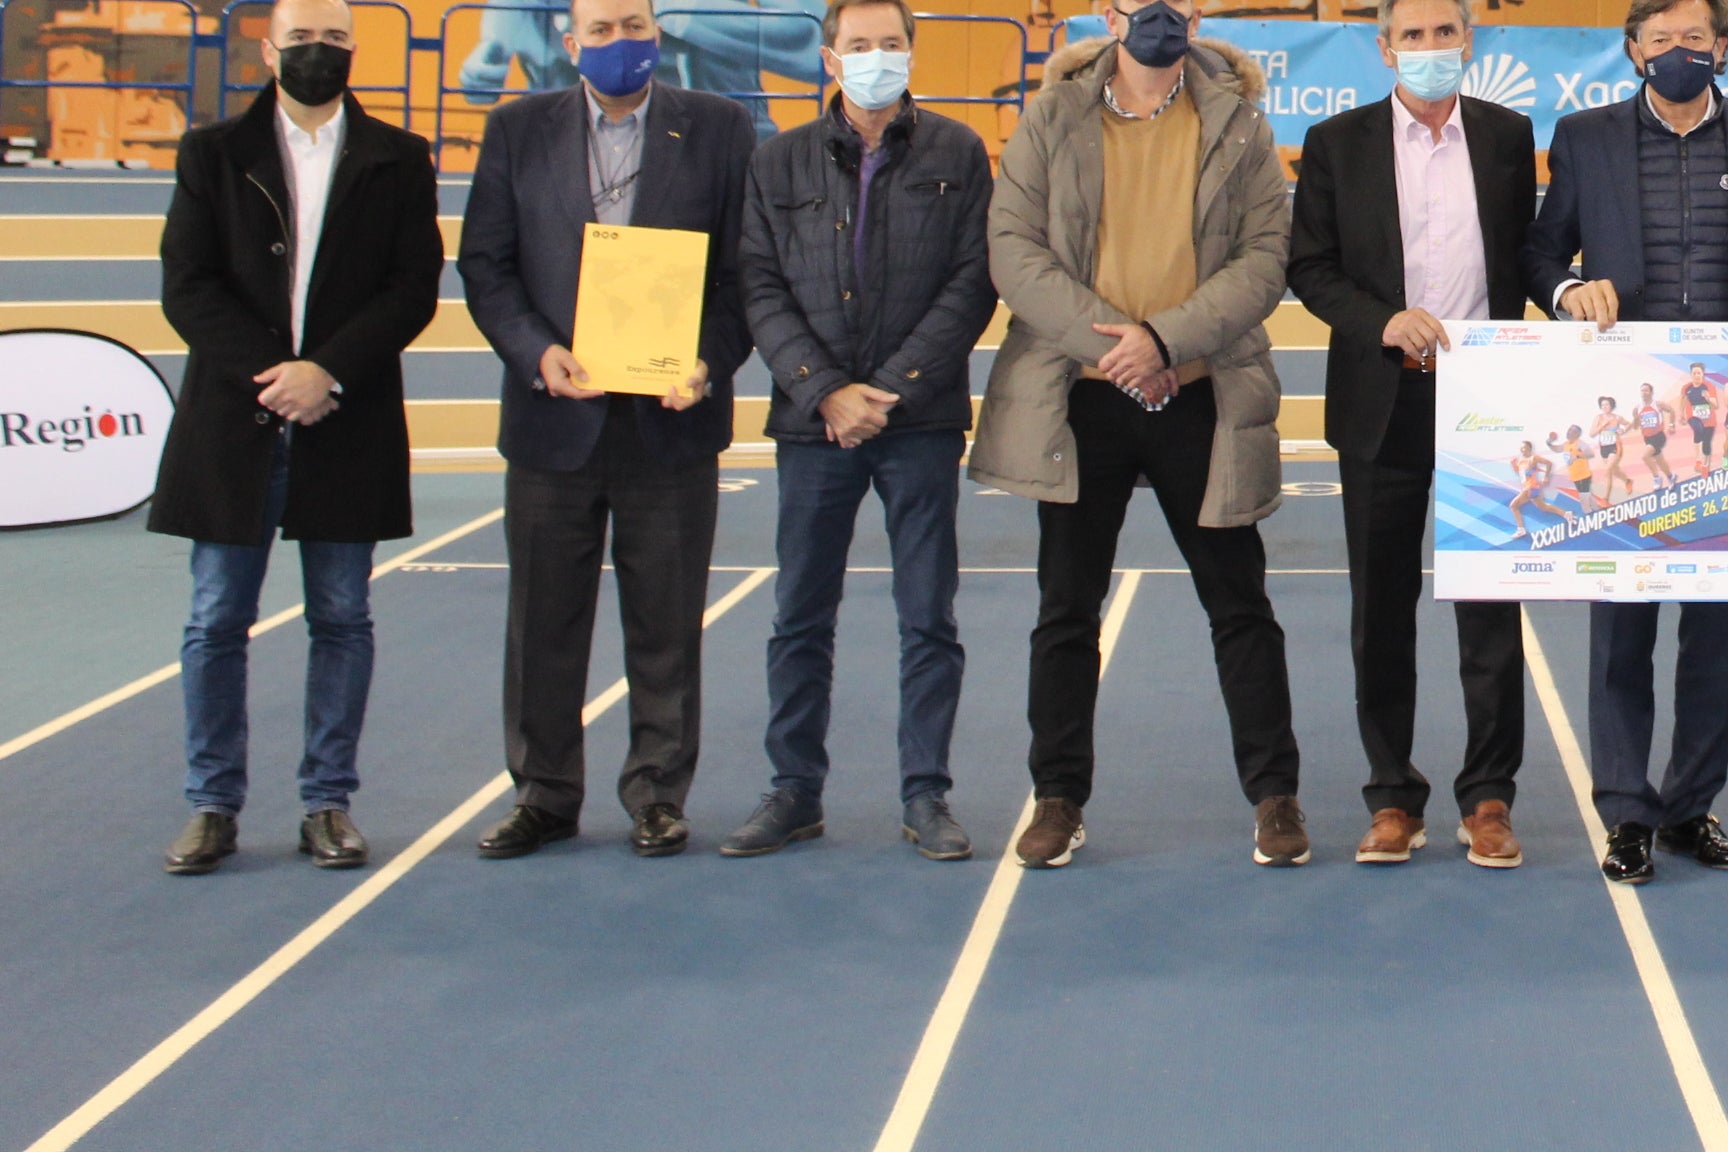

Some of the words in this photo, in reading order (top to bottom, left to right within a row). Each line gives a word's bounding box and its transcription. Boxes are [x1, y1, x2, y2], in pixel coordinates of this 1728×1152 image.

[1258, 85, 1357, 116] ALICIA
[1596, 335, 1632, 343] OURENSE
[1530, 522, 1565, 550] XXXII
[1567, 494, 1658, 539] CAMPEONATO
[1660, 490, 1678, 509] de
[1638, 505, 1697, 539] OURENSE
